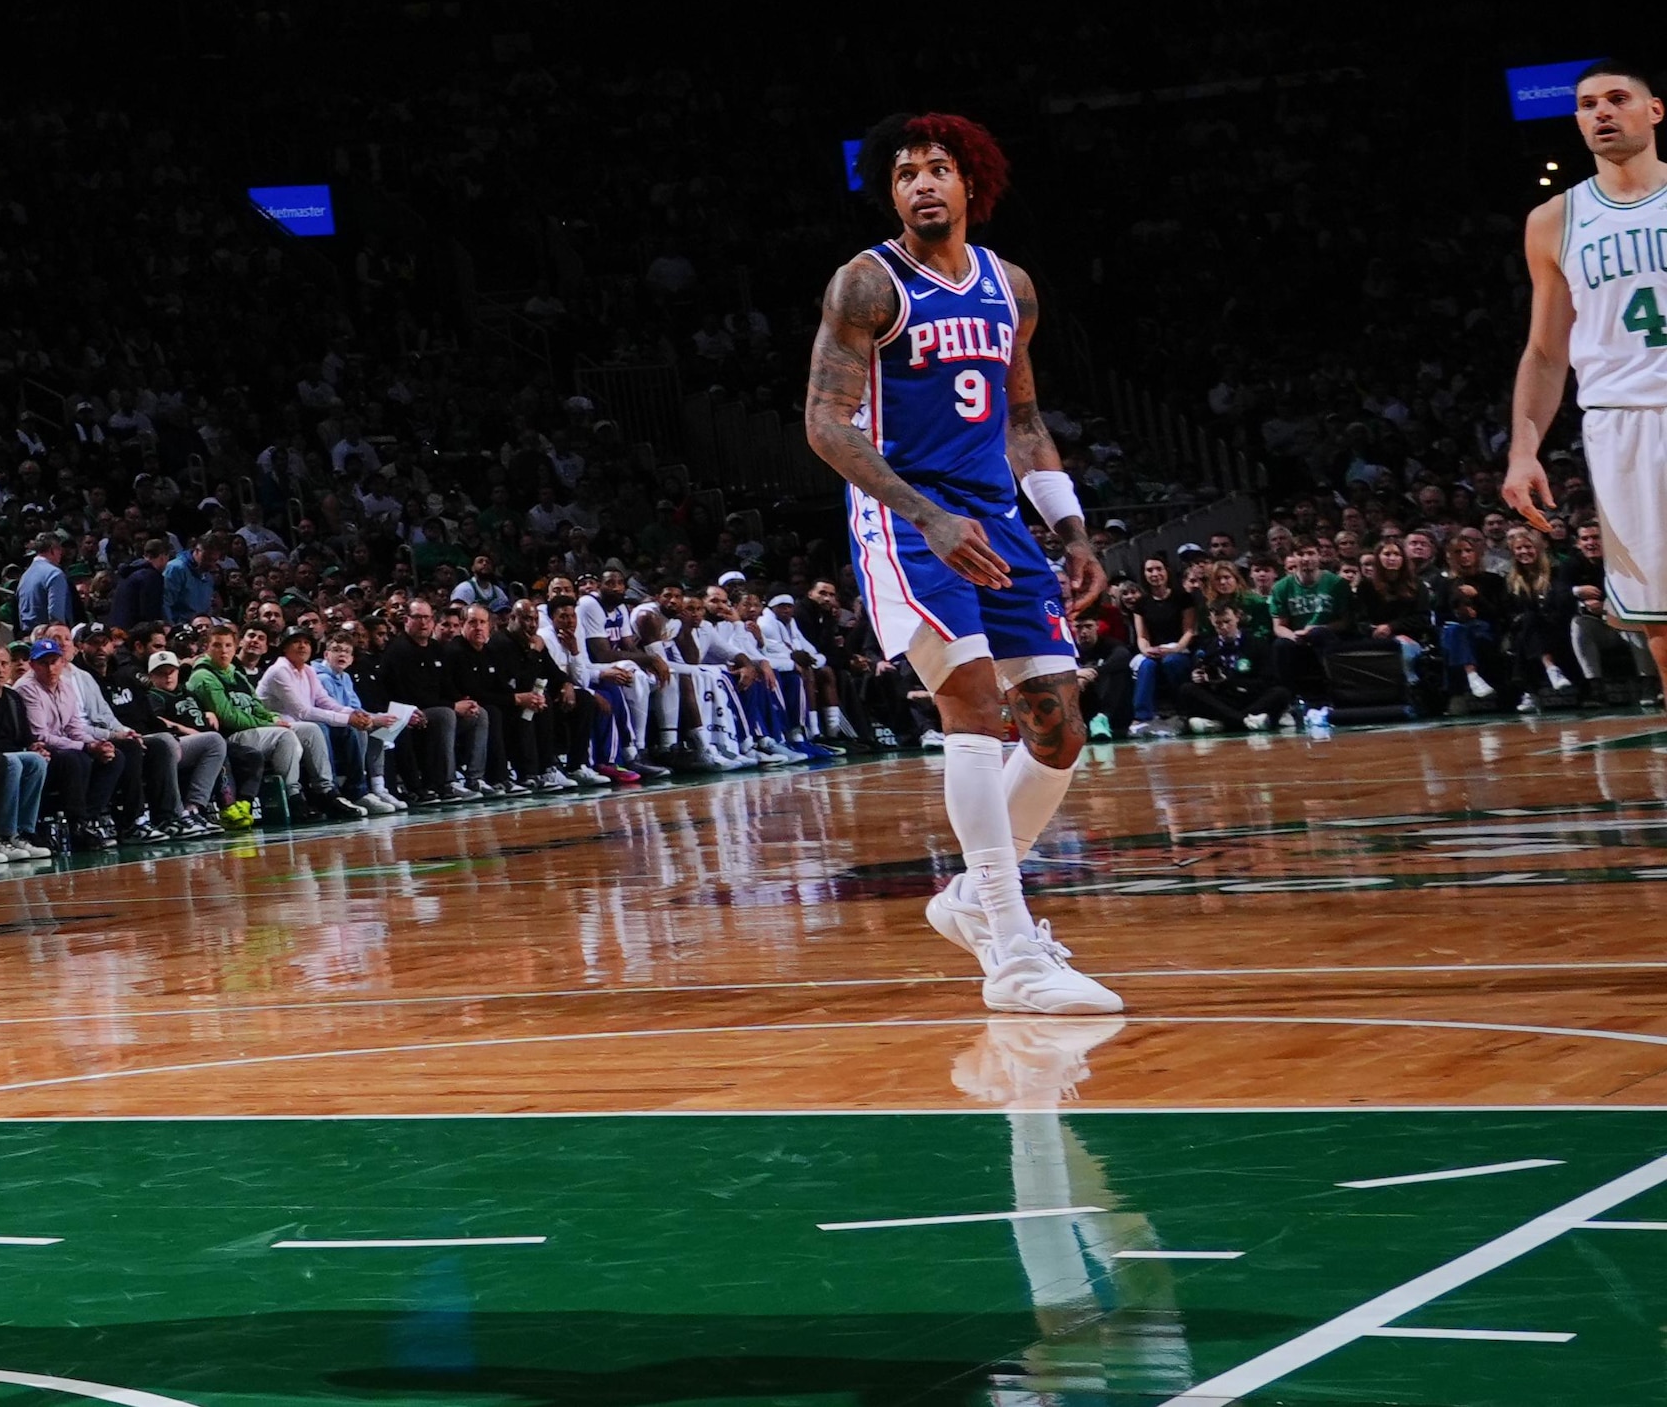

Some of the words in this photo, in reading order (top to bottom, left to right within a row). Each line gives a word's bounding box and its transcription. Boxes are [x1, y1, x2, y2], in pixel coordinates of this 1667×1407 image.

[1581, 228, 1667, 289] CELTIC
[908, 317, 1013, 370] PHILA
[1622, 287, 1667, 347] 4
[954, 369, 991, 424] 9
